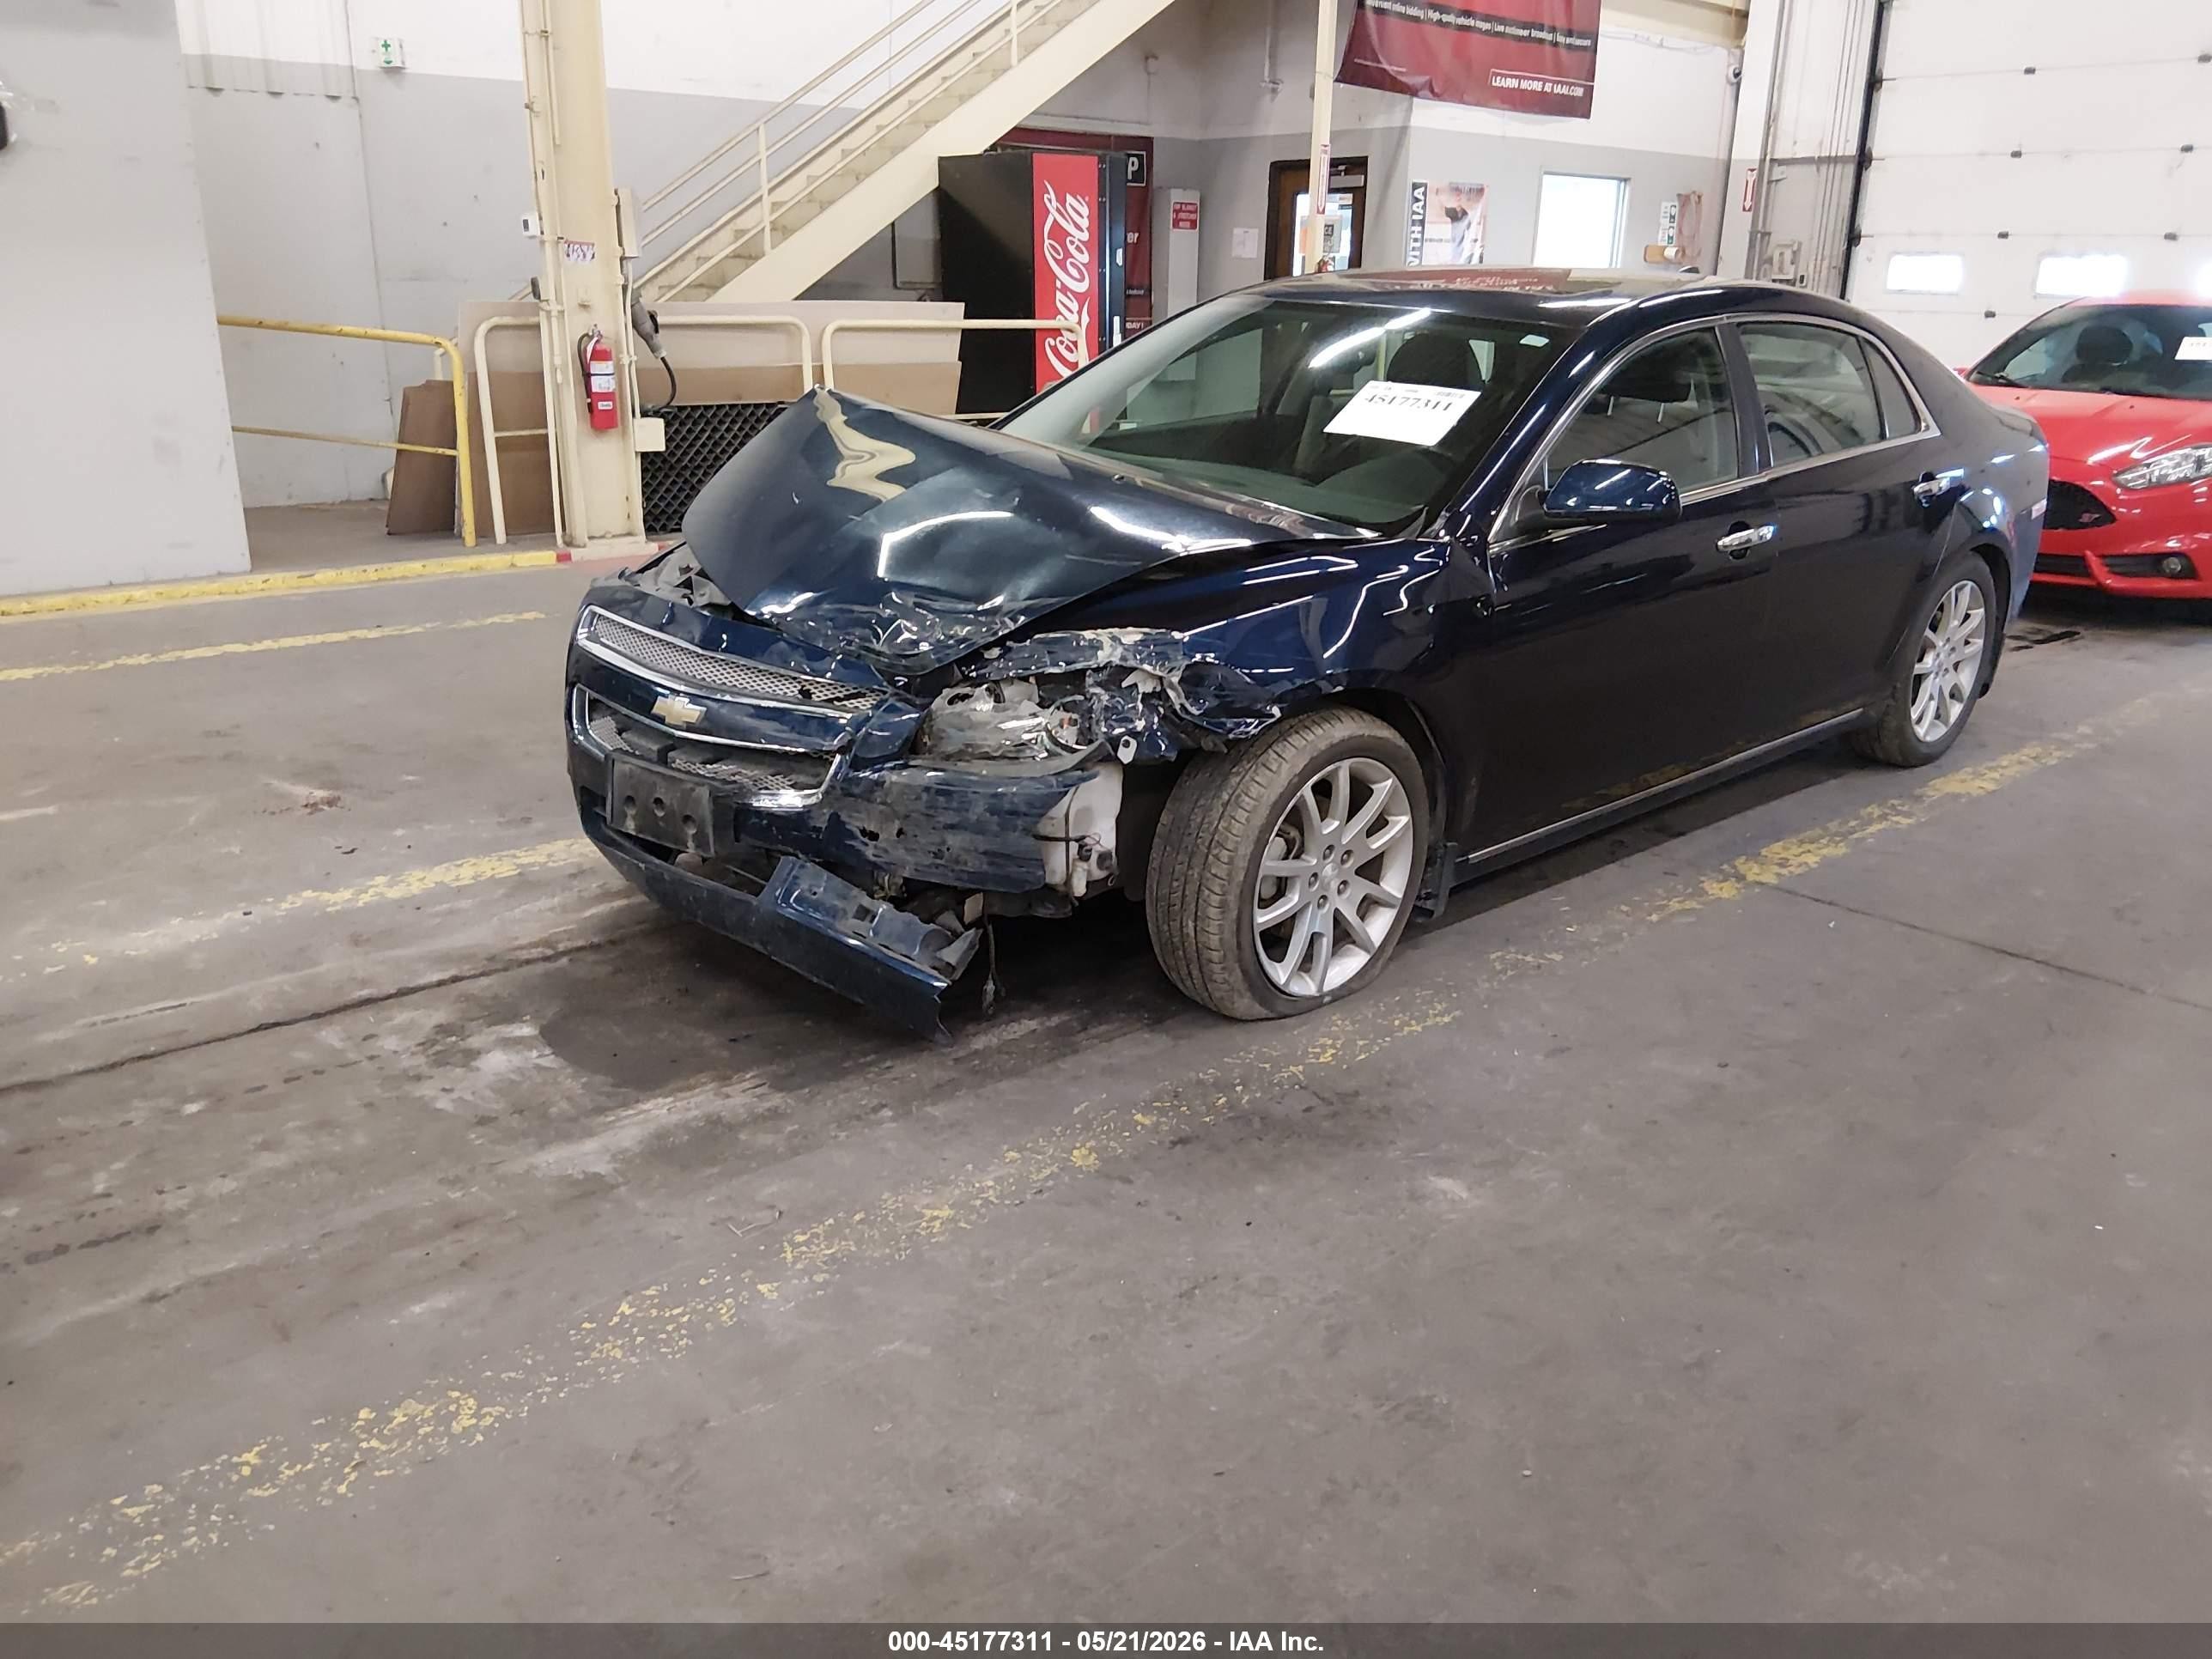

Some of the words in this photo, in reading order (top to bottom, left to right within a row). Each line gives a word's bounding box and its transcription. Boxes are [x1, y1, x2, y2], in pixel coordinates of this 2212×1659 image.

[1492, 76, 1519, 88] LEARN
[1520, 79, 1543, 92] MORE
[1543, 82, 1553, 93] AT
[1412, 186, 1425, 220] IAA
